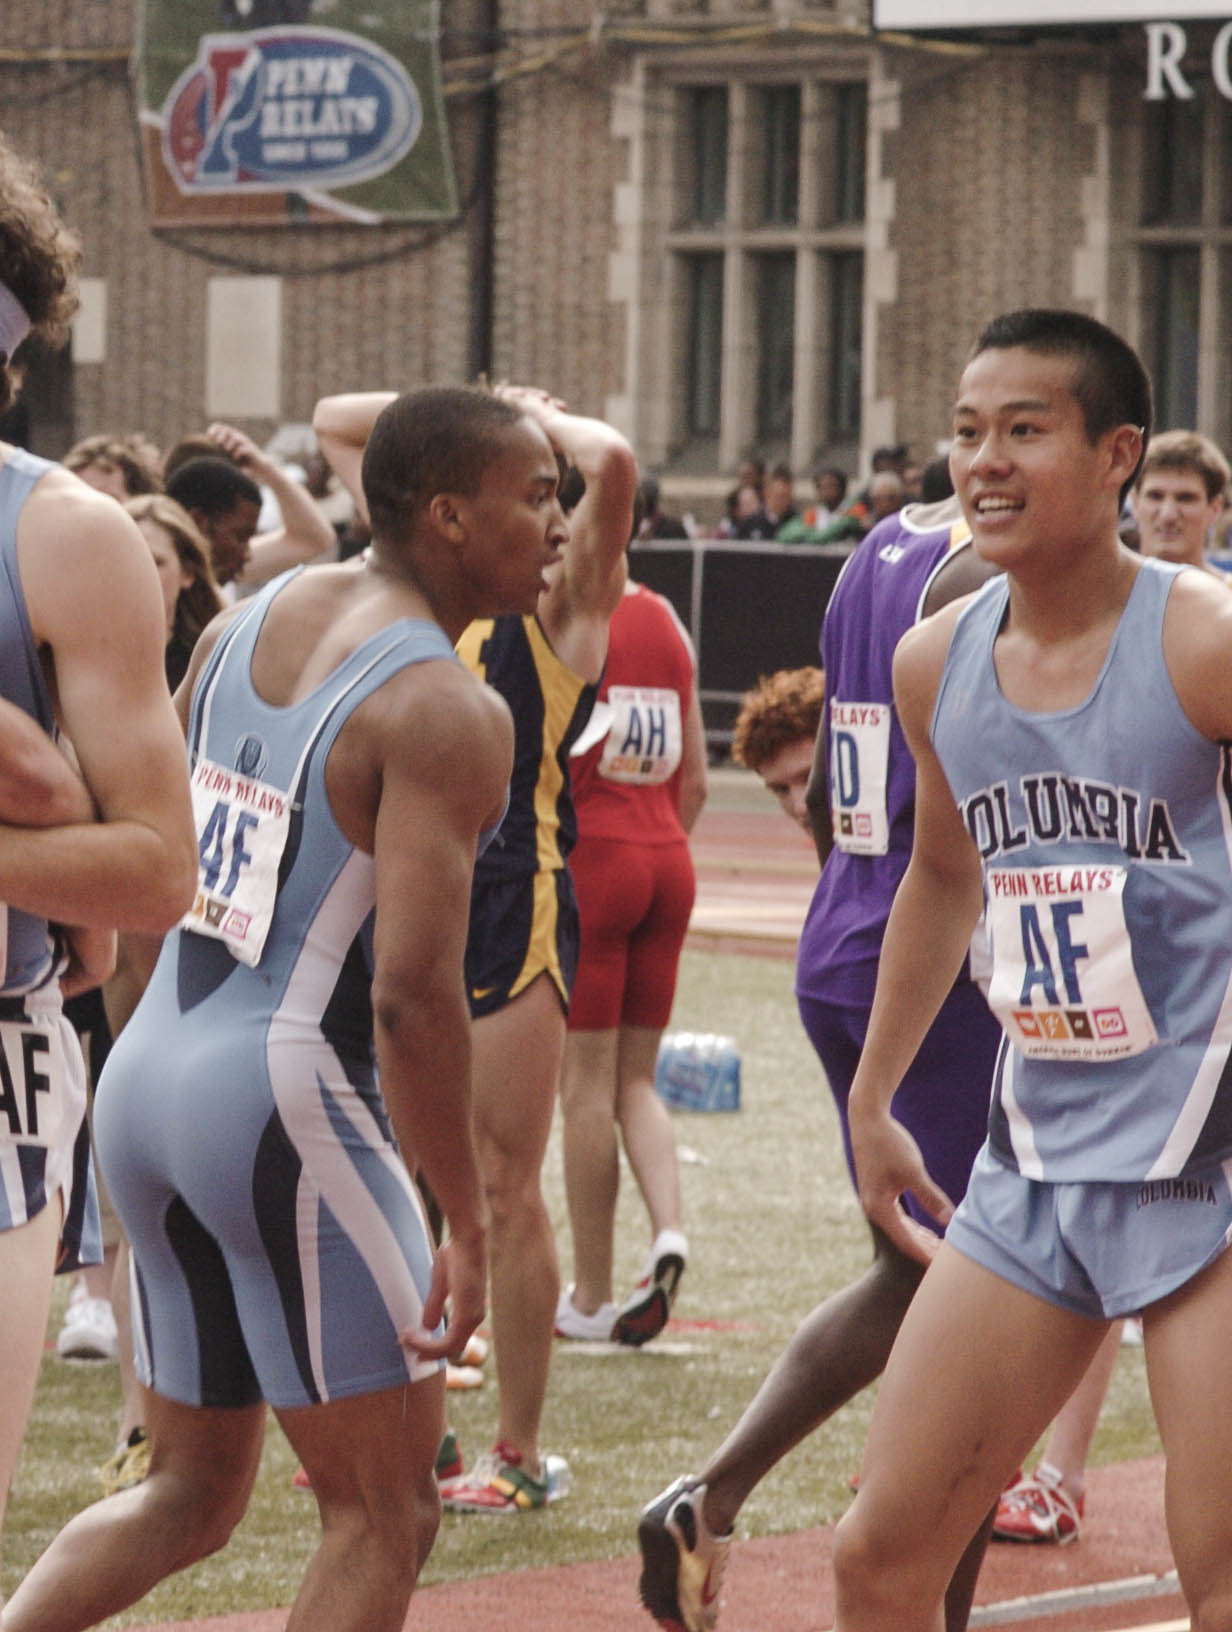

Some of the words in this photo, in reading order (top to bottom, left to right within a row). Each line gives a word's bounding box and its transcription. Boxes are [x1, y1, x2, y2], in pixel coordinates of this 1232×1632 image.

[264, 58, 351, 96] PENN
[259, 97, 379, 137] RELAYS
[620, 706, 665, 757] AH
[198, 766, 233, 795] PENN
[235, 781, 284, 818] RELAYS
[836, 731, 860, 807] D
[961, 772, 1192, 866] OLUMBIA
[199, 801, 260, 897] AF
[992, 872, 1028, 897] PENN
[1032, 870, 1113, 895] RELAYS
[1019, 900, 1089, 1006] AF
